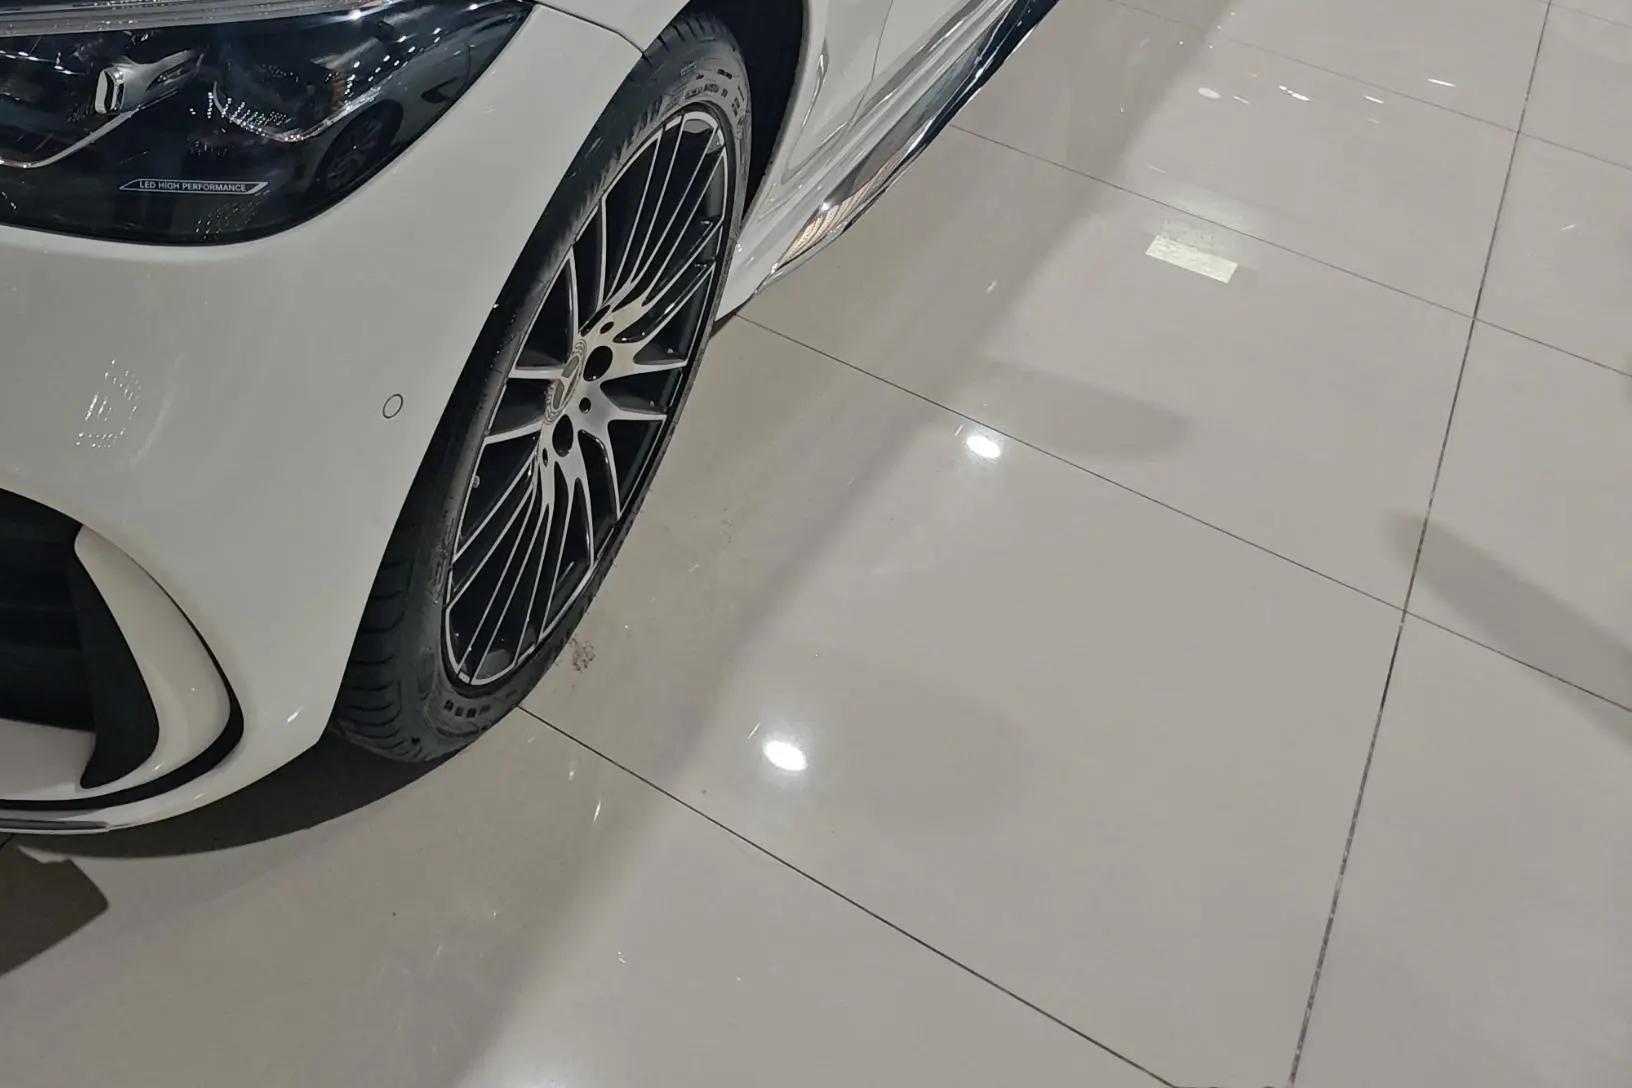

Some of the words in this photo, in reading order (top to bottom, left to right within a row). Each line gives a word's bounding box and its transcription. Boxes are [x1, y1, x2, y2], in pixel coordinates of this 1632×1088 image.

[139, 180, 156, 189] LED
[158, 181, 180, 190] HIGH
[182, 182, 247, 192] PERFORMANCE
